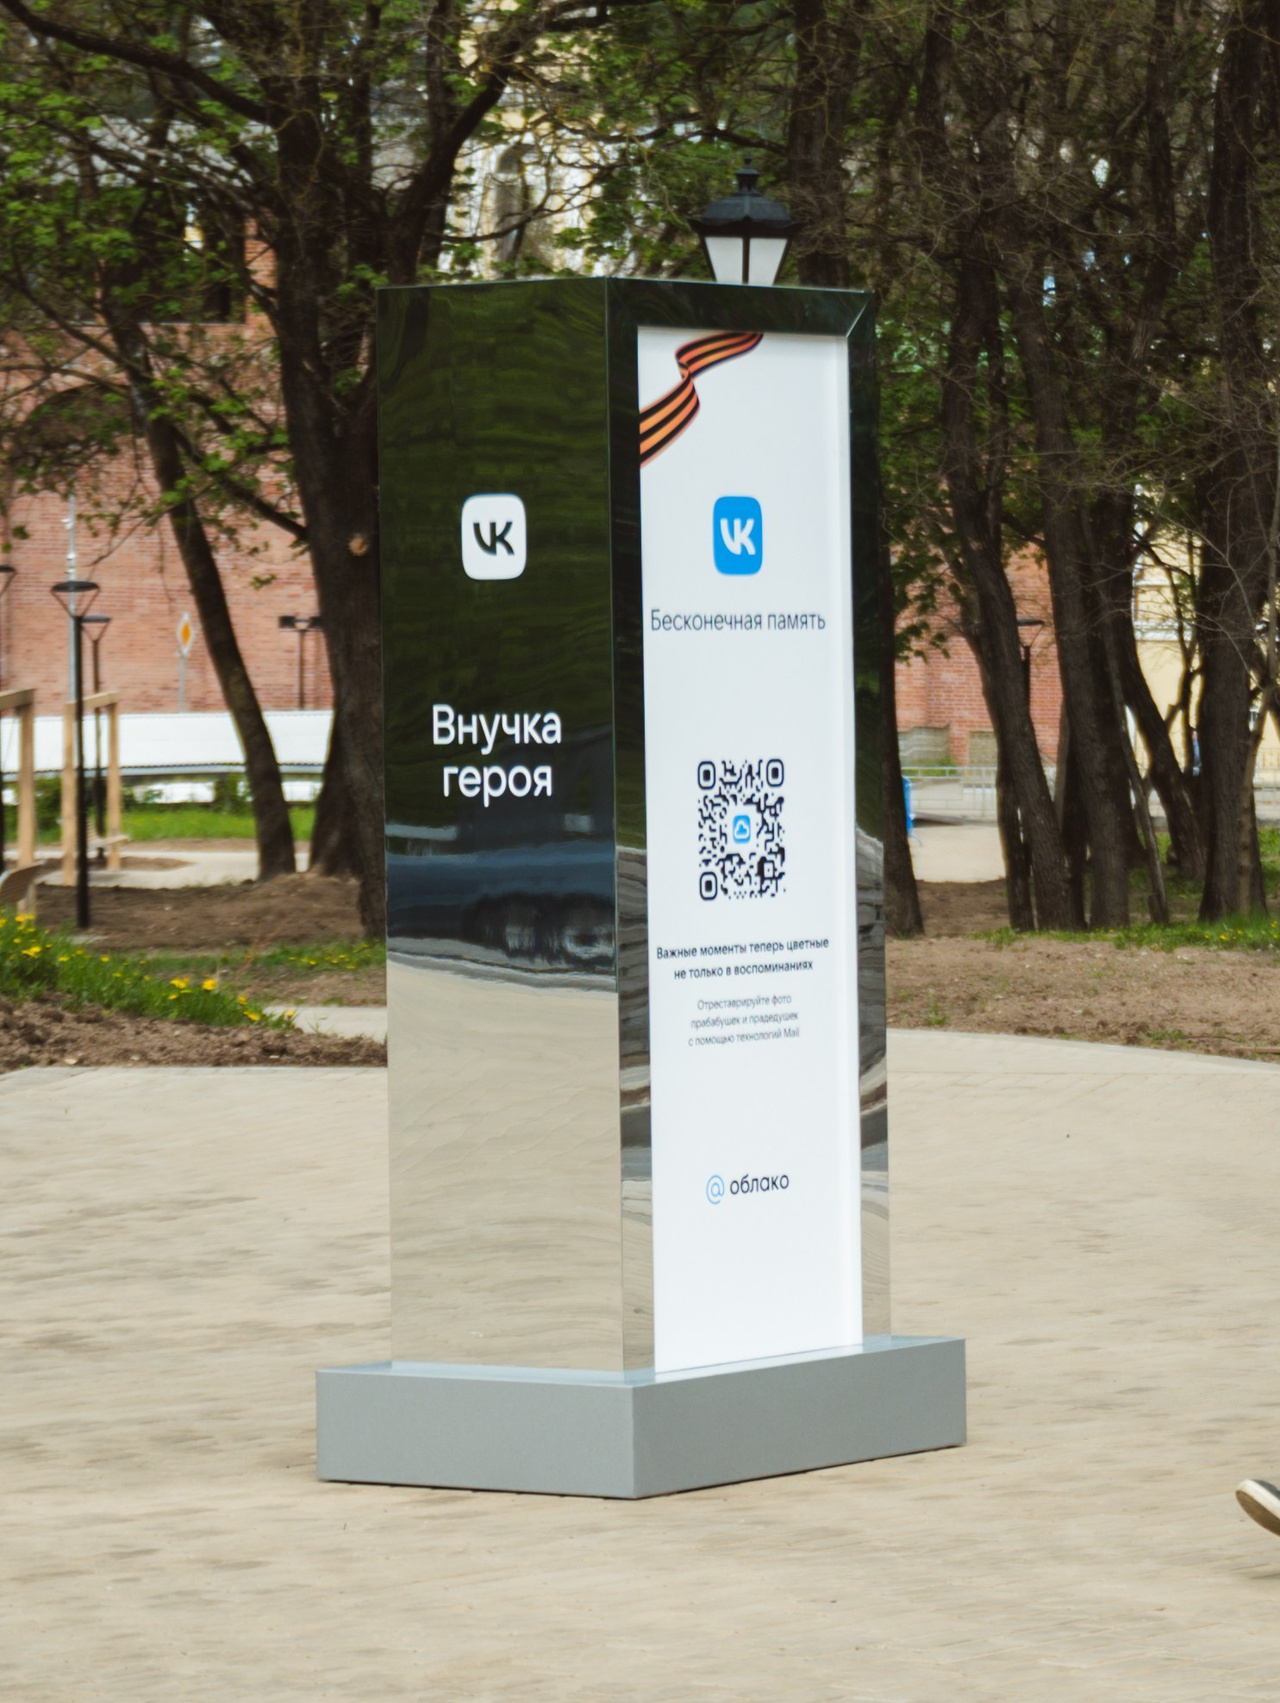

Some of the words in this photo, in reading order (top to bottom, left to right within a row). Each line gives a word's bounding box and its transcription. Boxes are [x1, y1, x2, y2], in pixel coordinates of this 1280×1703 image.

[472, 521, 515, 556] VK
[719, 518, 756, 556] VK
[651, 608, 762, 631] Бесконечная
[767, 613, 826, 631] память
[432, 704, 562, 755] Внучка
[443, 765, 552, 808] героя
[656, 946, 698, 960] Важные
[700, 943, 747, 957] моменты
[749, 940, 785, 955] теперь
[786, 937, 830, 952] цветные
[673, 969, 687, 981] не
[689, 965, 724, 979] только
[725, 966, 732, 977] в
[734, 960, 813, 976] воспоминаниях
[697, 995, 770, 1012] Отреставрируйте
[771, 993, 792, 1007] фото
[690, 1015, 741, 1030] прабабушек
[742, 1016, 748, 1025] и
[749, 1011, 799, 1027] прадедушек
[688, 1038, 694, 1047] с
[695, 1033, 735, 1047] помощью
[736, 1029, 782, 1043] технологий
[783, 1027, 800, 1038] Mail
[729, 1173, 790, 1196] облако
